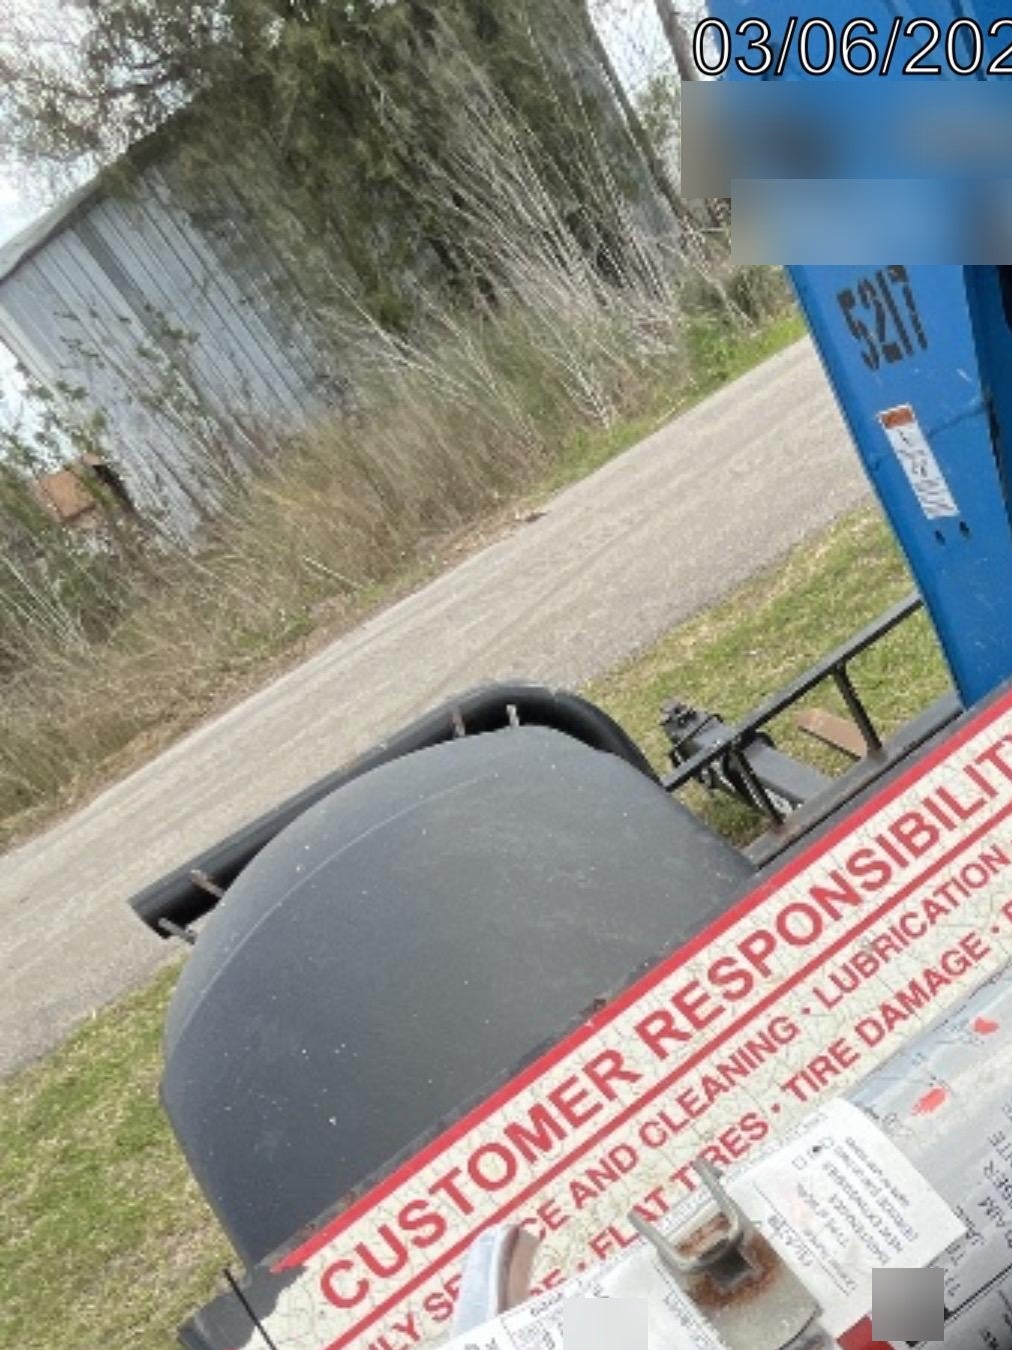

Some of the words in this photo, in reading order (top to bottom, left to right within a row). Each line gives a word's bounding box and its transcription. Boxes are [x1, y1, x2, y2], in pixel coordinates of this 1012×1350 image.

[561, 1131, 651, 1212] AND
[634, 1009, 802, 1153] CLEANING
[811, 840, 1012, 1012] LUBRICATION
[668, 1107, 772, 1198] TRES
[780, 1035, 862, 1108] TIRE
[853, 929, 992, 1049] DAMAGE
[312, 1041, 645, 1317] CUSTOMER
[977, 1194, 1010, 1229] AIM
